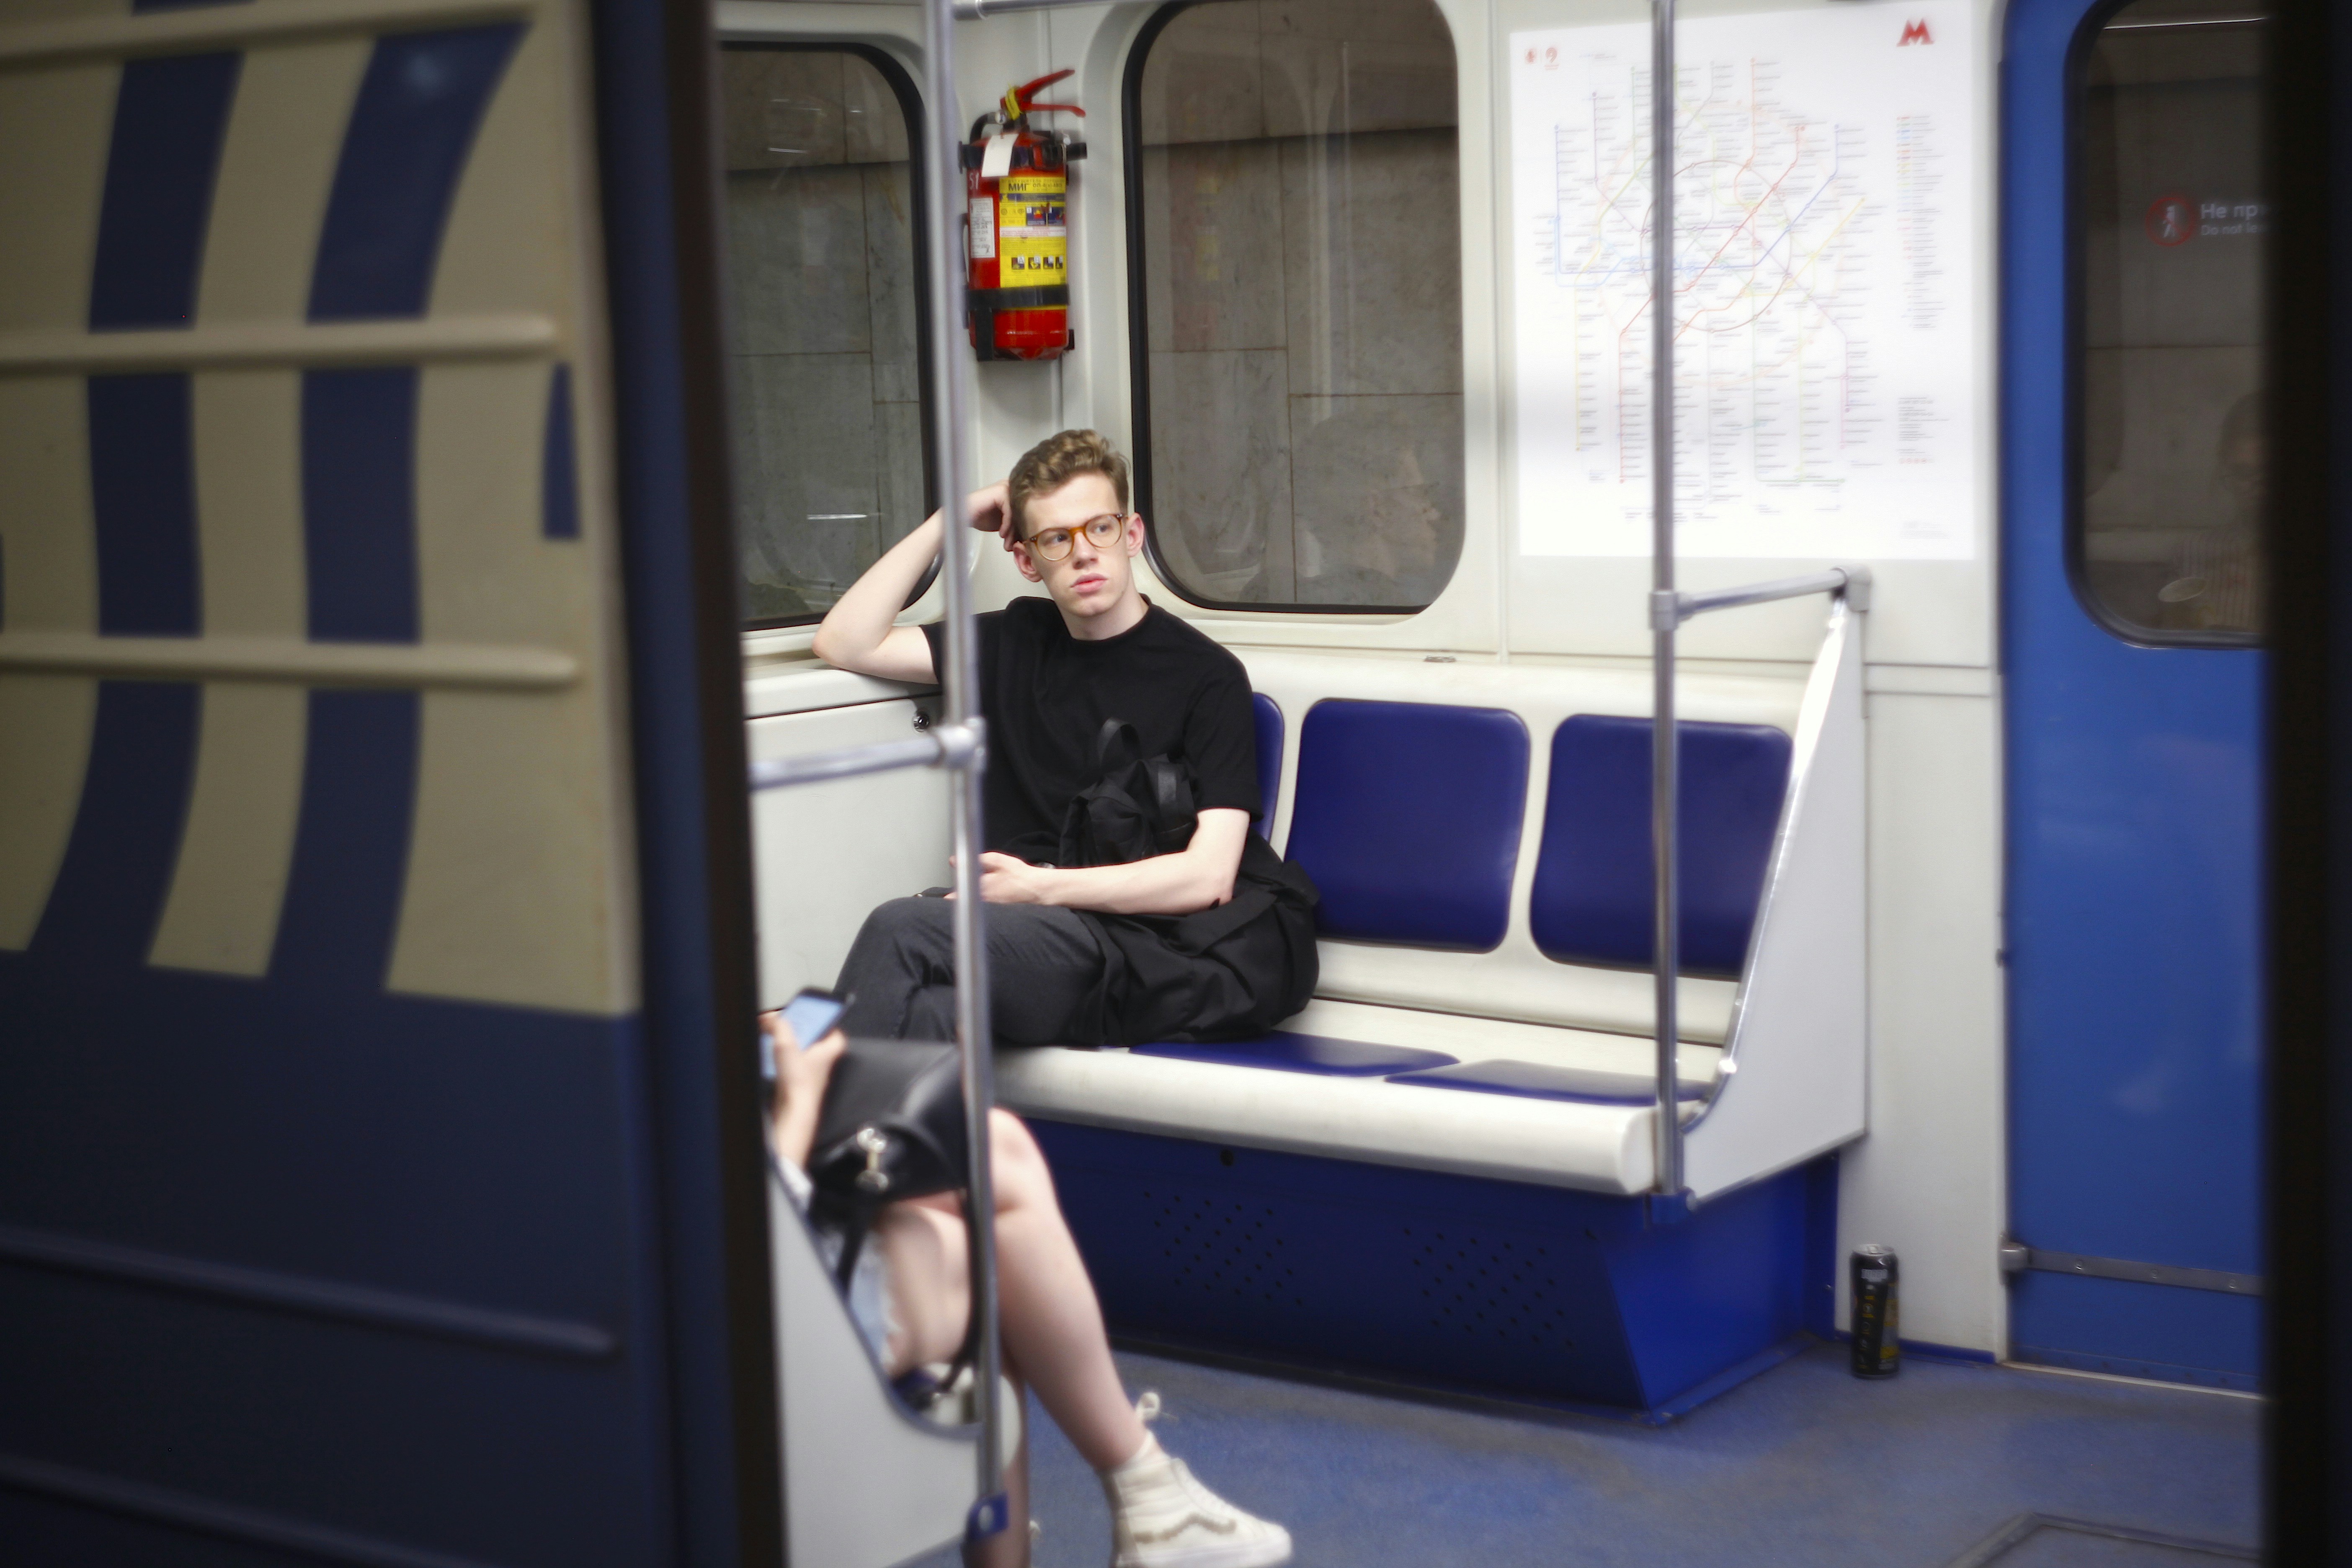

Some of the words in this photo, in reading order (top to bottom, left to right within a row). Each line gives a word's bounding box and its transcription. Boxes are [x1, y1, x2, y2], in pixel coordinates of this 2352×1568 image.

[1008, 183, 1030, 191] МИГ
[2201, 203, 2227, 219] Не
[2233, 205, 2259, 221] пр
[2246, 222, 2259, 233] le
